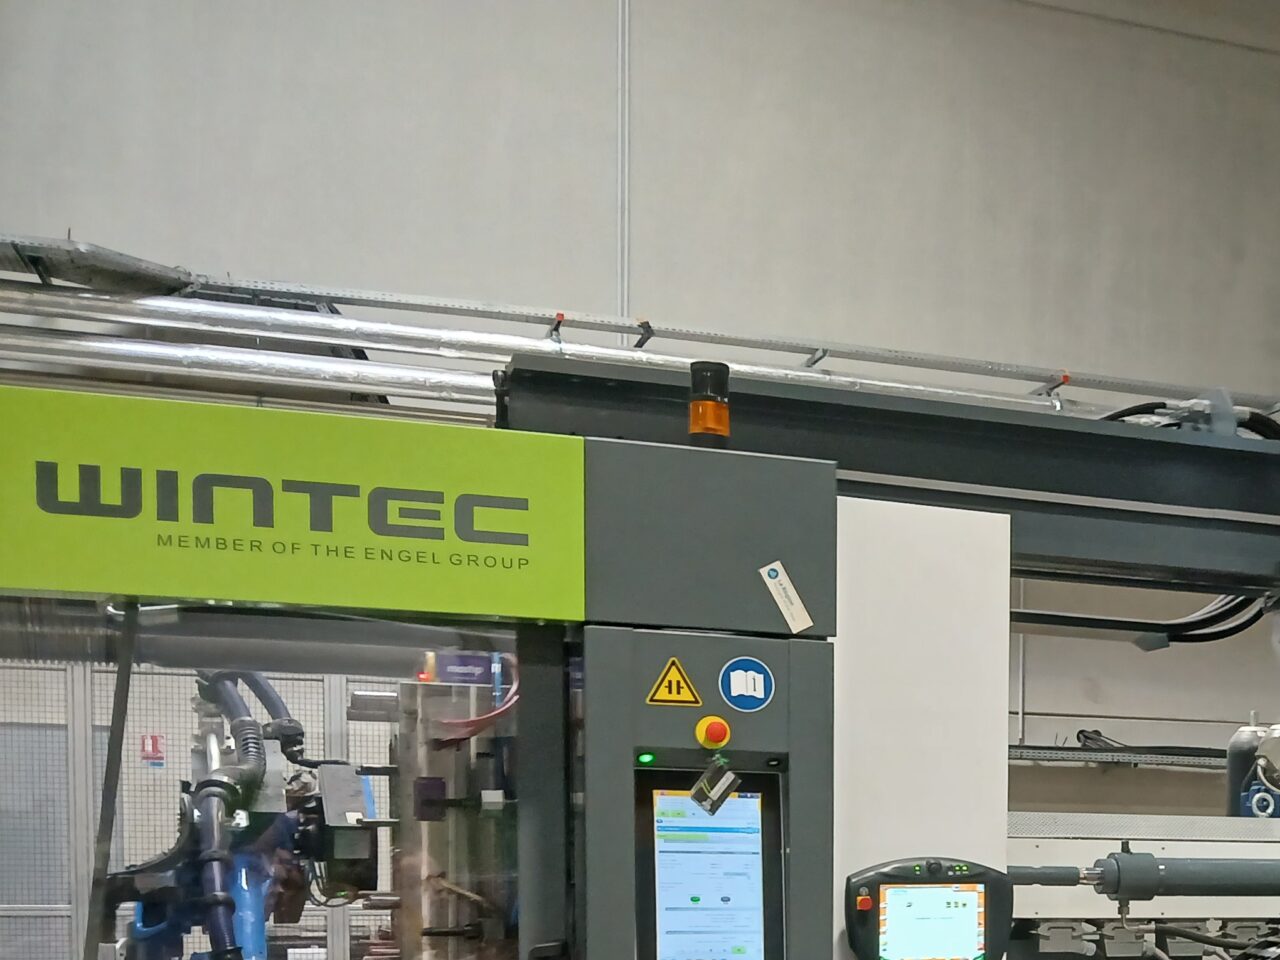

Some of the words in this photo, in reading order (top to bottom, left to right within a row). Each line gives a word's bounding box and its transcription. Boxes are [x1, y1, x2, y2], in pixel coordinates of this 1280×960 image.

[36, 460, 529, 546] WINTEC
[157, 534, 263, 552] MEMBER
[272, 540, 303, 555] OF
[311, 544, 356, 559] THE
[364, 547, 441, 565] ENGEL
[449, 553, 530, 569] GROUP
